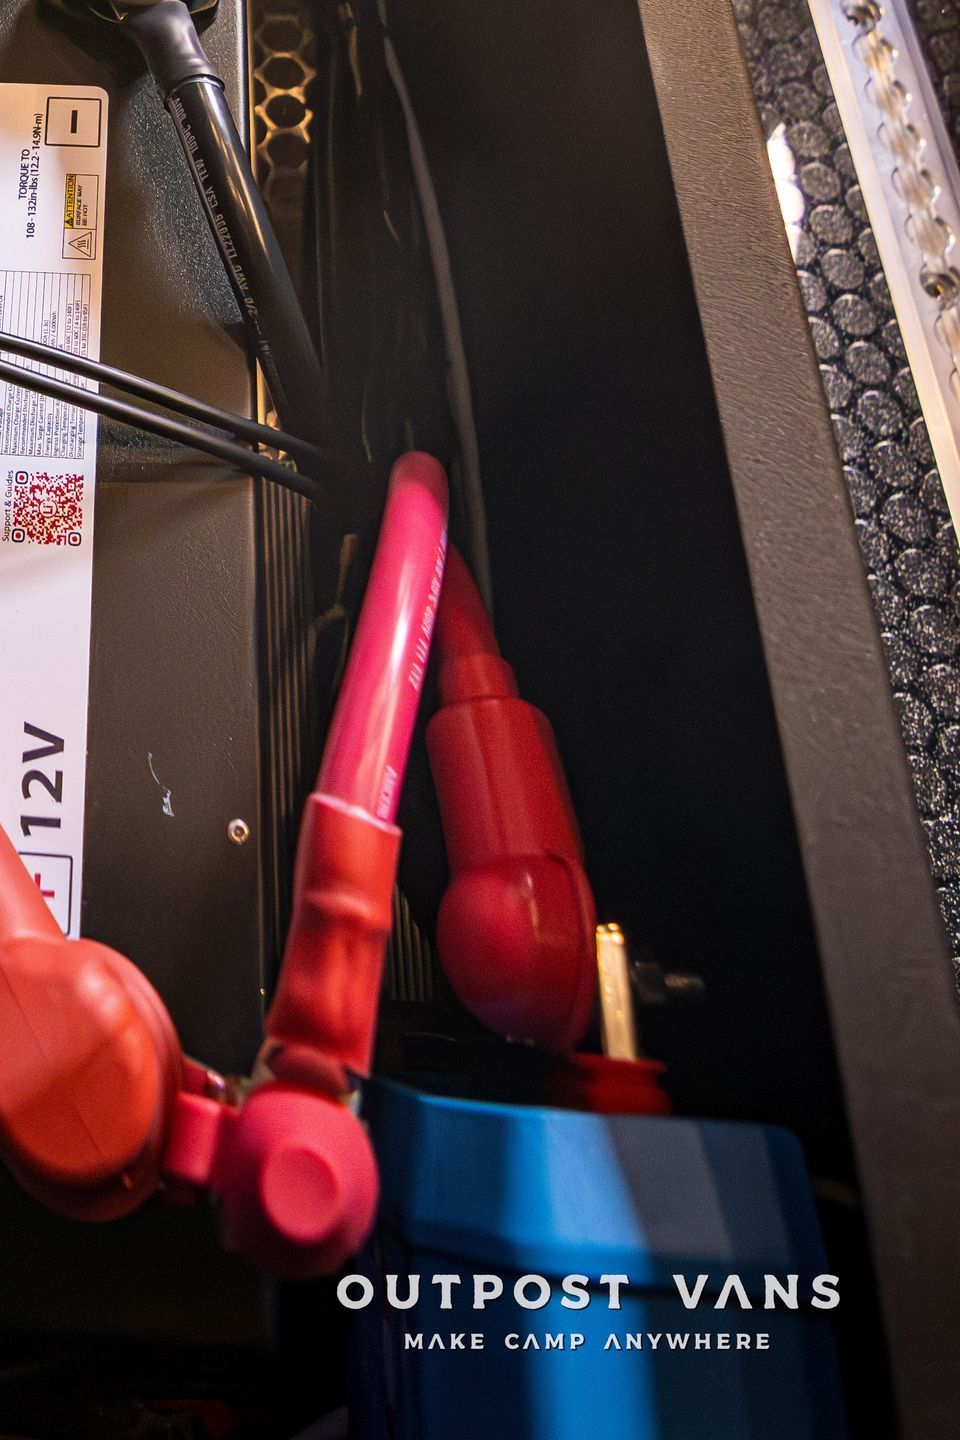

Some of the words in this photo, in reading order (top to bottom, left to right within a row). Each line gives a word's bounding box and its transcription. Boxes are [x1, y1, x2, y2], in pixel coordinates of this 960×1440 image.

[21, 148, 30, 165] TO
[18, 167, 29, 200] TORQUE
[66, 175, 74, 218] ATTENTION
[26, 221, 35, 239] 108
[5, 470, 14, 498] Guides
[2, 507, 12, 543] Support
[21, 720, 66, 837] 12V
